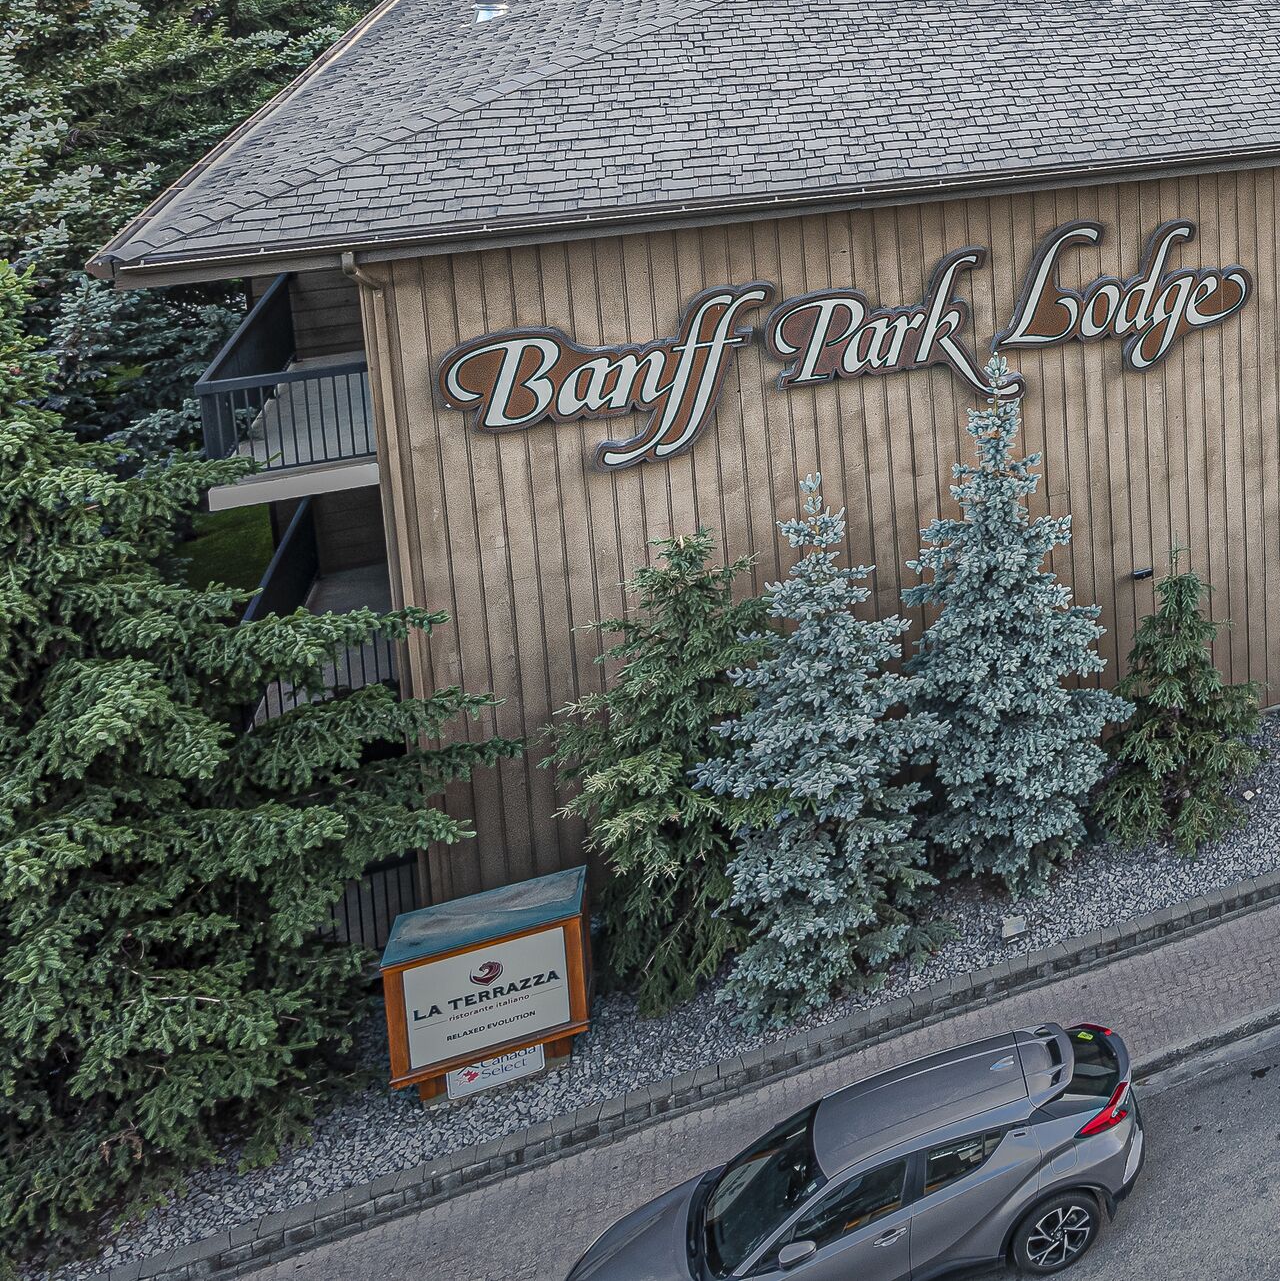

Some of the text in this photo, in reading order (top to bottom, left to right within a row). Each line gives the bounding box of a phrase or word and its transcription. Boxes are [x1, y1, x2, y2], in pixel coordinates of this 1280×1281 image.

[447, 223, 1250, 468] Banff Park Lodge
[413, 970, 561, 1022] LA TERRAZZA
[449, 993, 530, 1022] ristorante italiano
[446, 1010, 536, 1042] RELAXED EVOLUTION
[481, 1058, 528, 1080] Select
